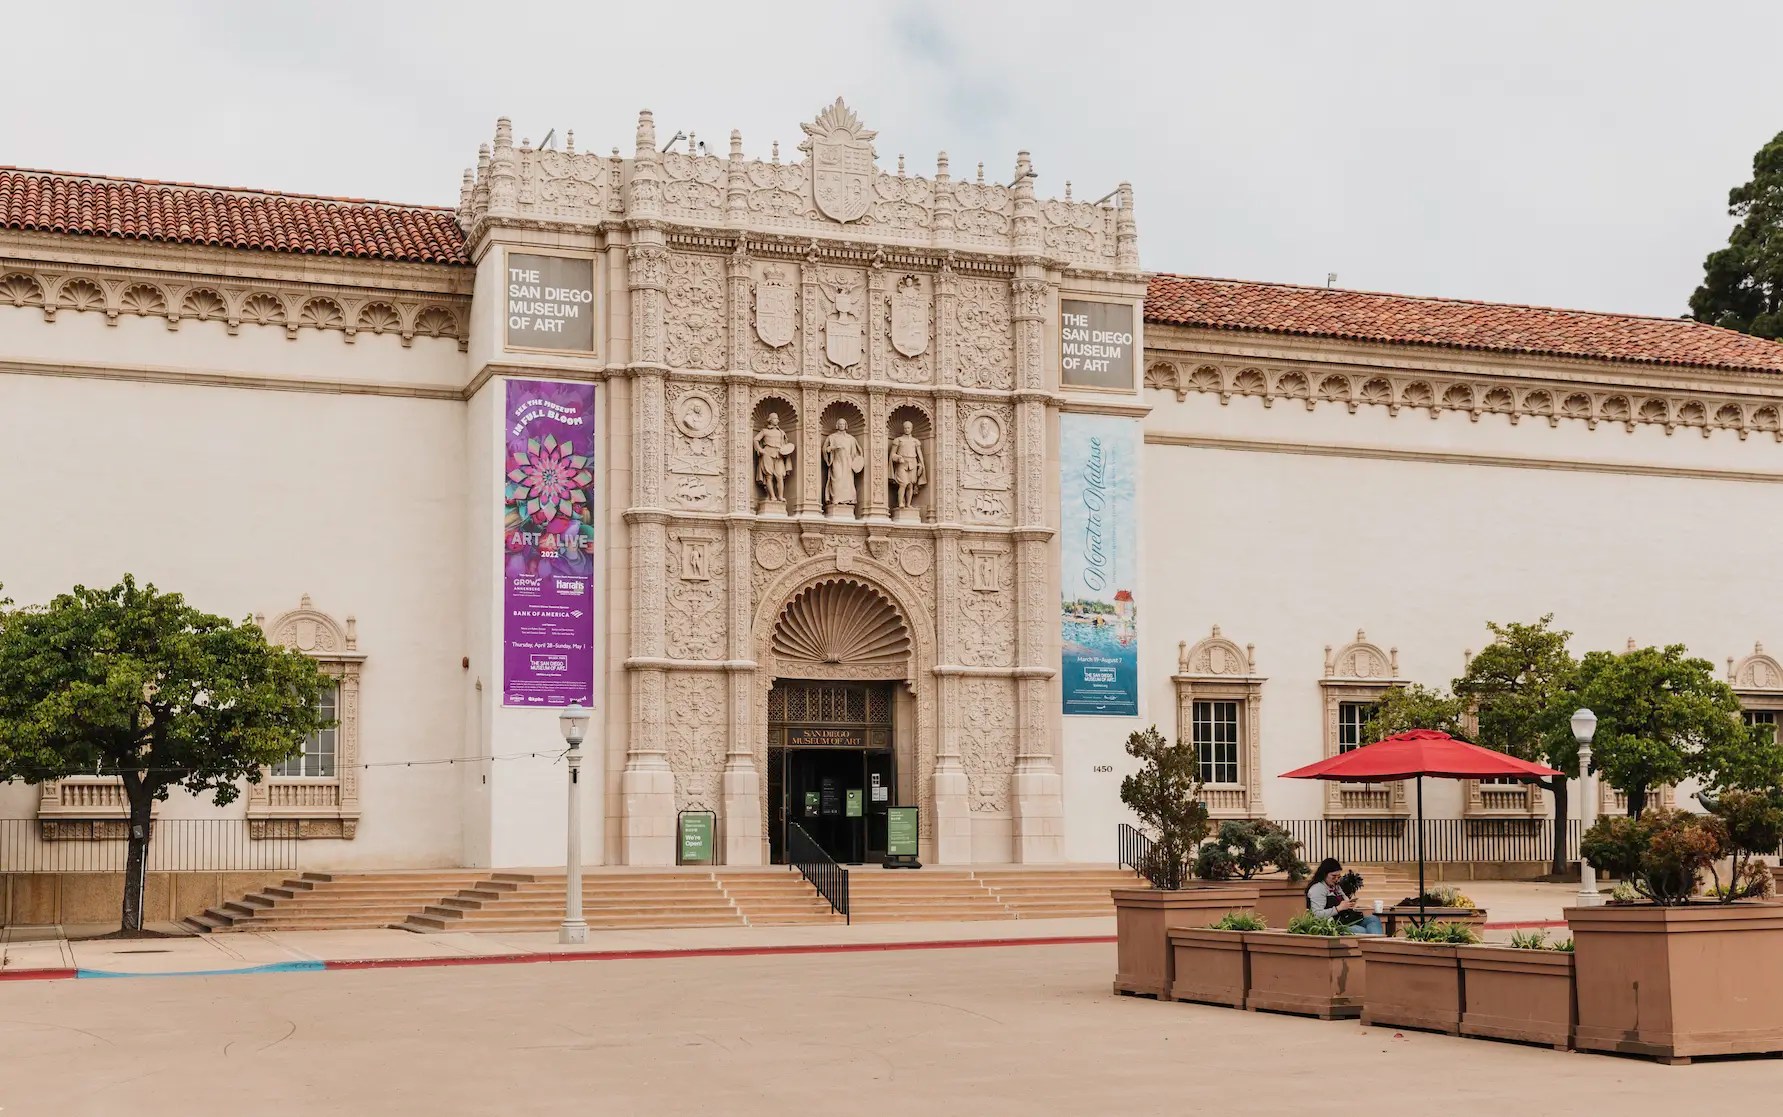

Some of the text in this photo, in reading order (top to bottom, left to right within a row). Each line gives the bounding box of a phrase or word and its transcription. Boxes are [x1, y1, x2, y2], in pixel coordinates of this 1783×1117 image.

[509, 268, 540, 283] THE
[509, 284, 593, 303] SAN DIEGO
[509, 300, 579, 318] MUSEUM
[509, 316, 565, 333] OF ART
[1062, 313, 1088, 327] THE
[1062, 328, 1133, 345] SAN DIEGO
[1062, 342, 1121, 358] MUSEUM
[1062, 357, 1110, 372] OF ART
[515, 399, 576, 417] SEE THE MUSEUM
[512, 409, 583, 437] IN FULL BLOOM
[1083, 436, 1107, 512] Matisse
[511, 531, 588, 548] ART ALIVE
[541, 550, 559, 558] 2022
[1083, 526, 1107, 591] Monet
[512, 641, 533, 649] Thursday,
[572, 643, 582, 651] May
[792, 737, 829, 745] MUSEUM
[830, 737, 842, 745] OF
[803, 729, 850, 738] SAN DIEGO
[1093, 765, 1113, 773] 1450
